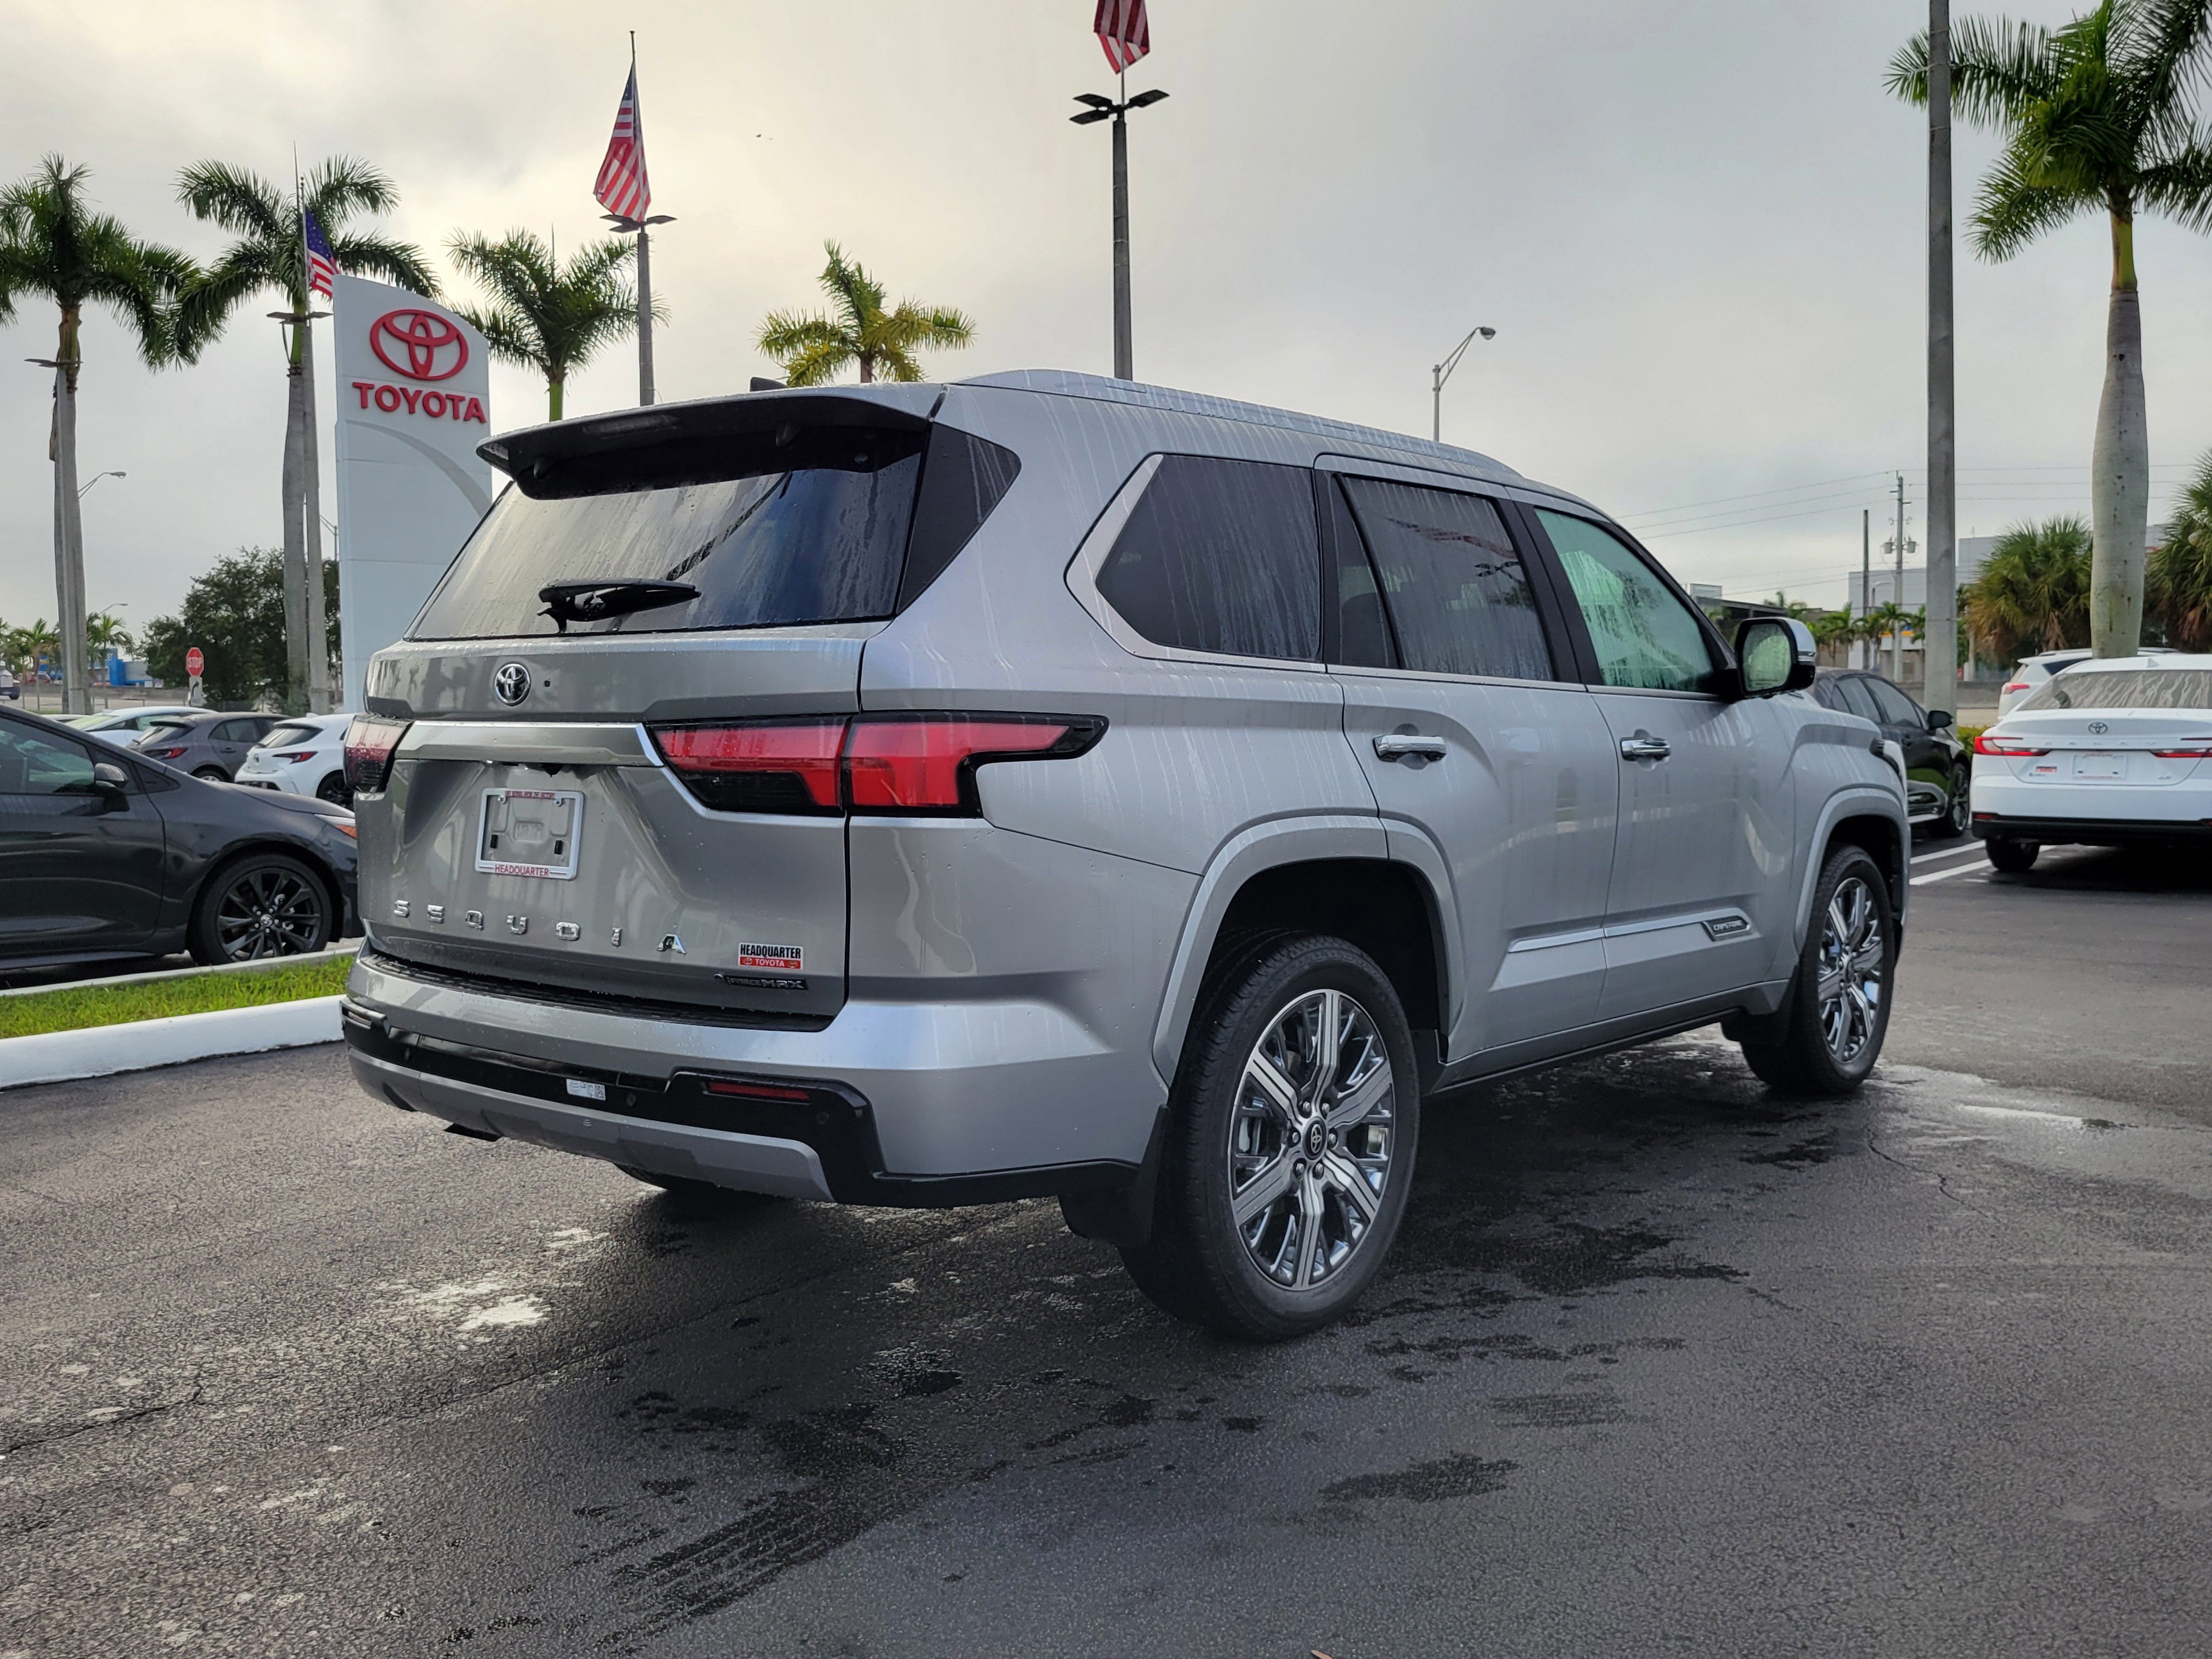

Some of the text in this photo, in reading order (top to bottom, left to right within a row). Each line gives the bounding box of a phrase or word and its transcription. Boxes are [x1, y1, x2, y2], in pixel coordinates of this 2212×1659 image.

[352, 381, 487, 424] TOYOTA
[188, 657, 203, 668] STOP
[393, 899, 687, 956] SEQUOIA
[741, 944, 801, 959] HEADQUARTER
[755, 958, 785, 967] TOYOTA
